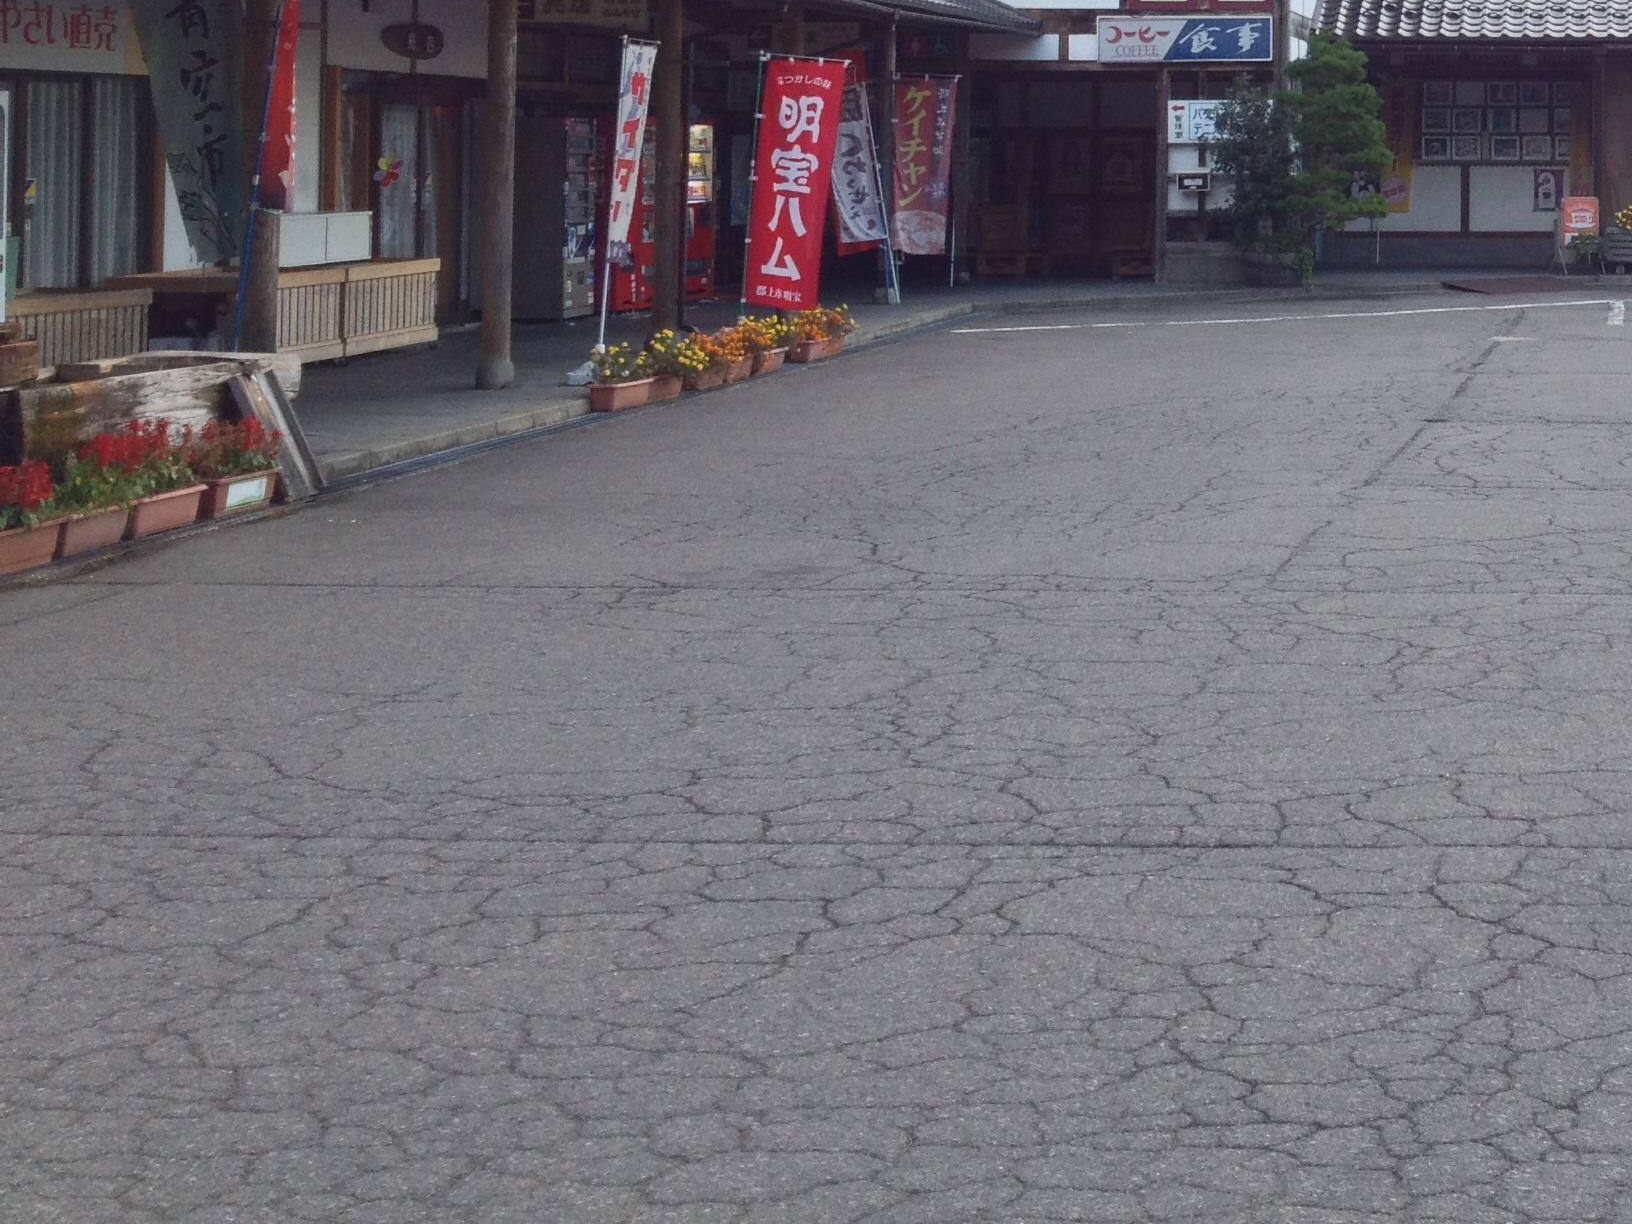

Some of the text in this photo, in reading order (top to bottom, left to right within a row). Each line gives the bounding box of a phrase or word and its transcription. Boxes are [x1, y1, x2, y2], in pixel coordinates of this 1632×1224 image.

[1105, 25, 1171, 44] コーヒー
[1114, 45, 1160, 56] COFFEE
[1179, 22, 1263, 55] 食事
[899, 85, 932, 208] ケイチャン
[760, 94, 825, 283] 明宝ハム
